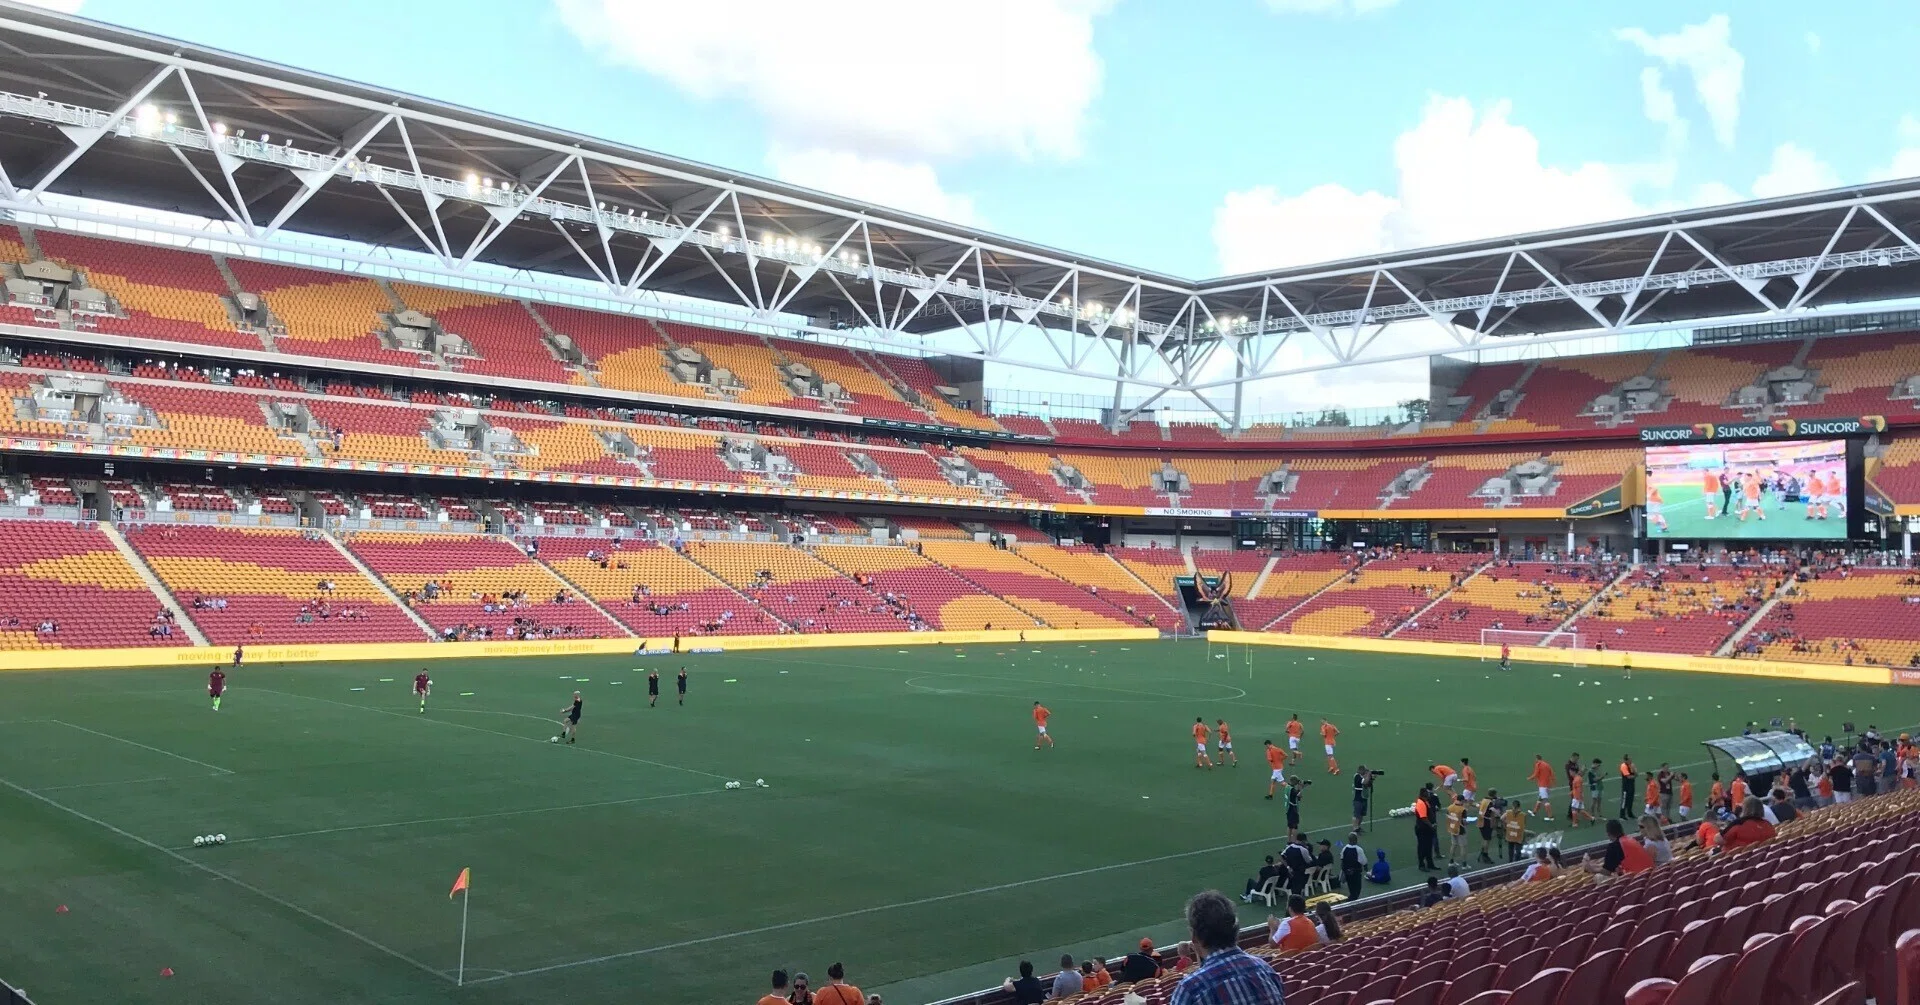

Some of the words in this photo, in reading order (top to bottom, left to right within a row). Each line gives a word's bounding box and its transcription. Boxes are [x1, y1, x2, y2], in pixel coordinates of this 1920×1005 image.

[1718, 426, 1773, 438] SUNCORP
[1800, 422, 1859, 435] SUNCORP
[1642, 429, 1692, 441] SUNCORP
[1176, 508, 1212, 516] SMOKING
[177, 650, 221, 661] moving
[225, 650, 264, 660] mney
[267, 648, 282, 659] for
[286, 647, 320, 659] better
[484, 645, 518, 655] moving
[521, 645, 551, 654] money
[553, 643, 566, 652] for
[568, 642, 594, 652] better
